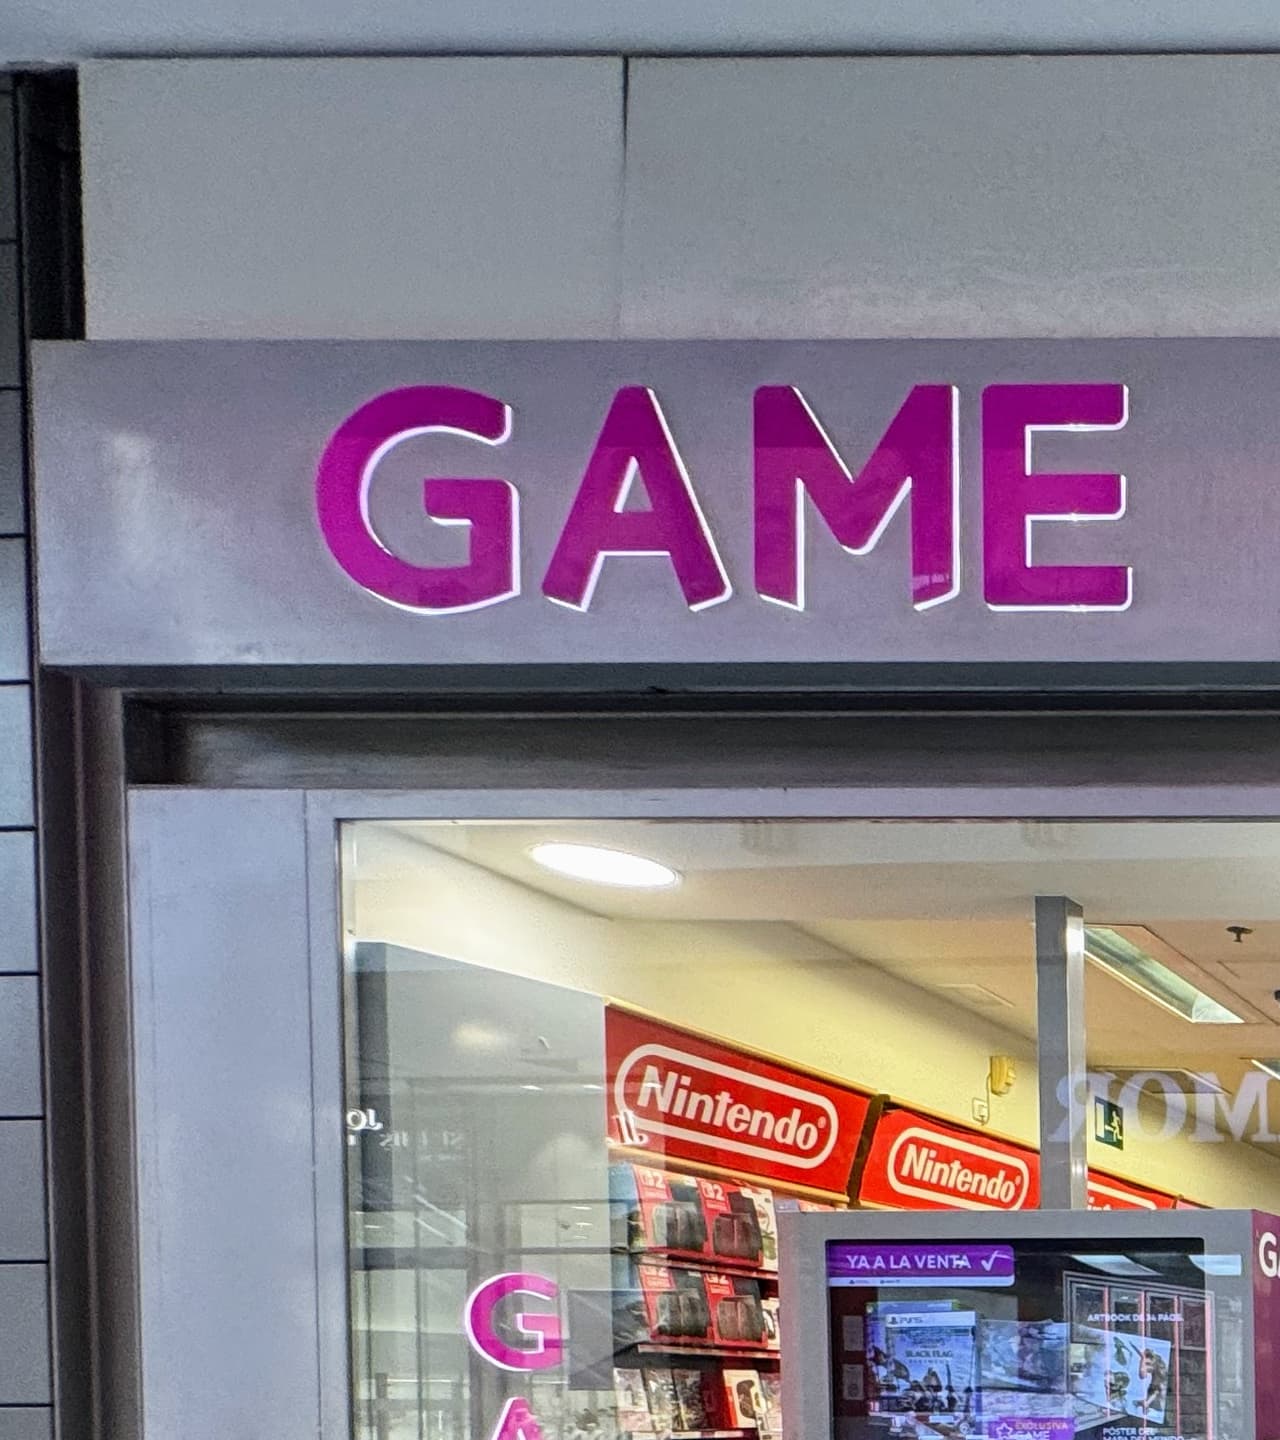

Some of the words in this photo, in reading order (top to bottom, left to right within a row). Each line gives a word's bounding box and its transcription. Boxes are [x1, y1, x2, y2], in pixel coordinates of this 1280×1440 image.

[315, 384, 1133, 614] GAME
[637, 1064, 820, 1153] Nintendo
[901, 1144, 1016, 1205] Nintendo
[847, 1255, 870, 1269] YA
[874, 1255, 886, 1269] A
[890, 1255, 909, 1269] LA
[914, 1254, 971, 1269] VENTA
